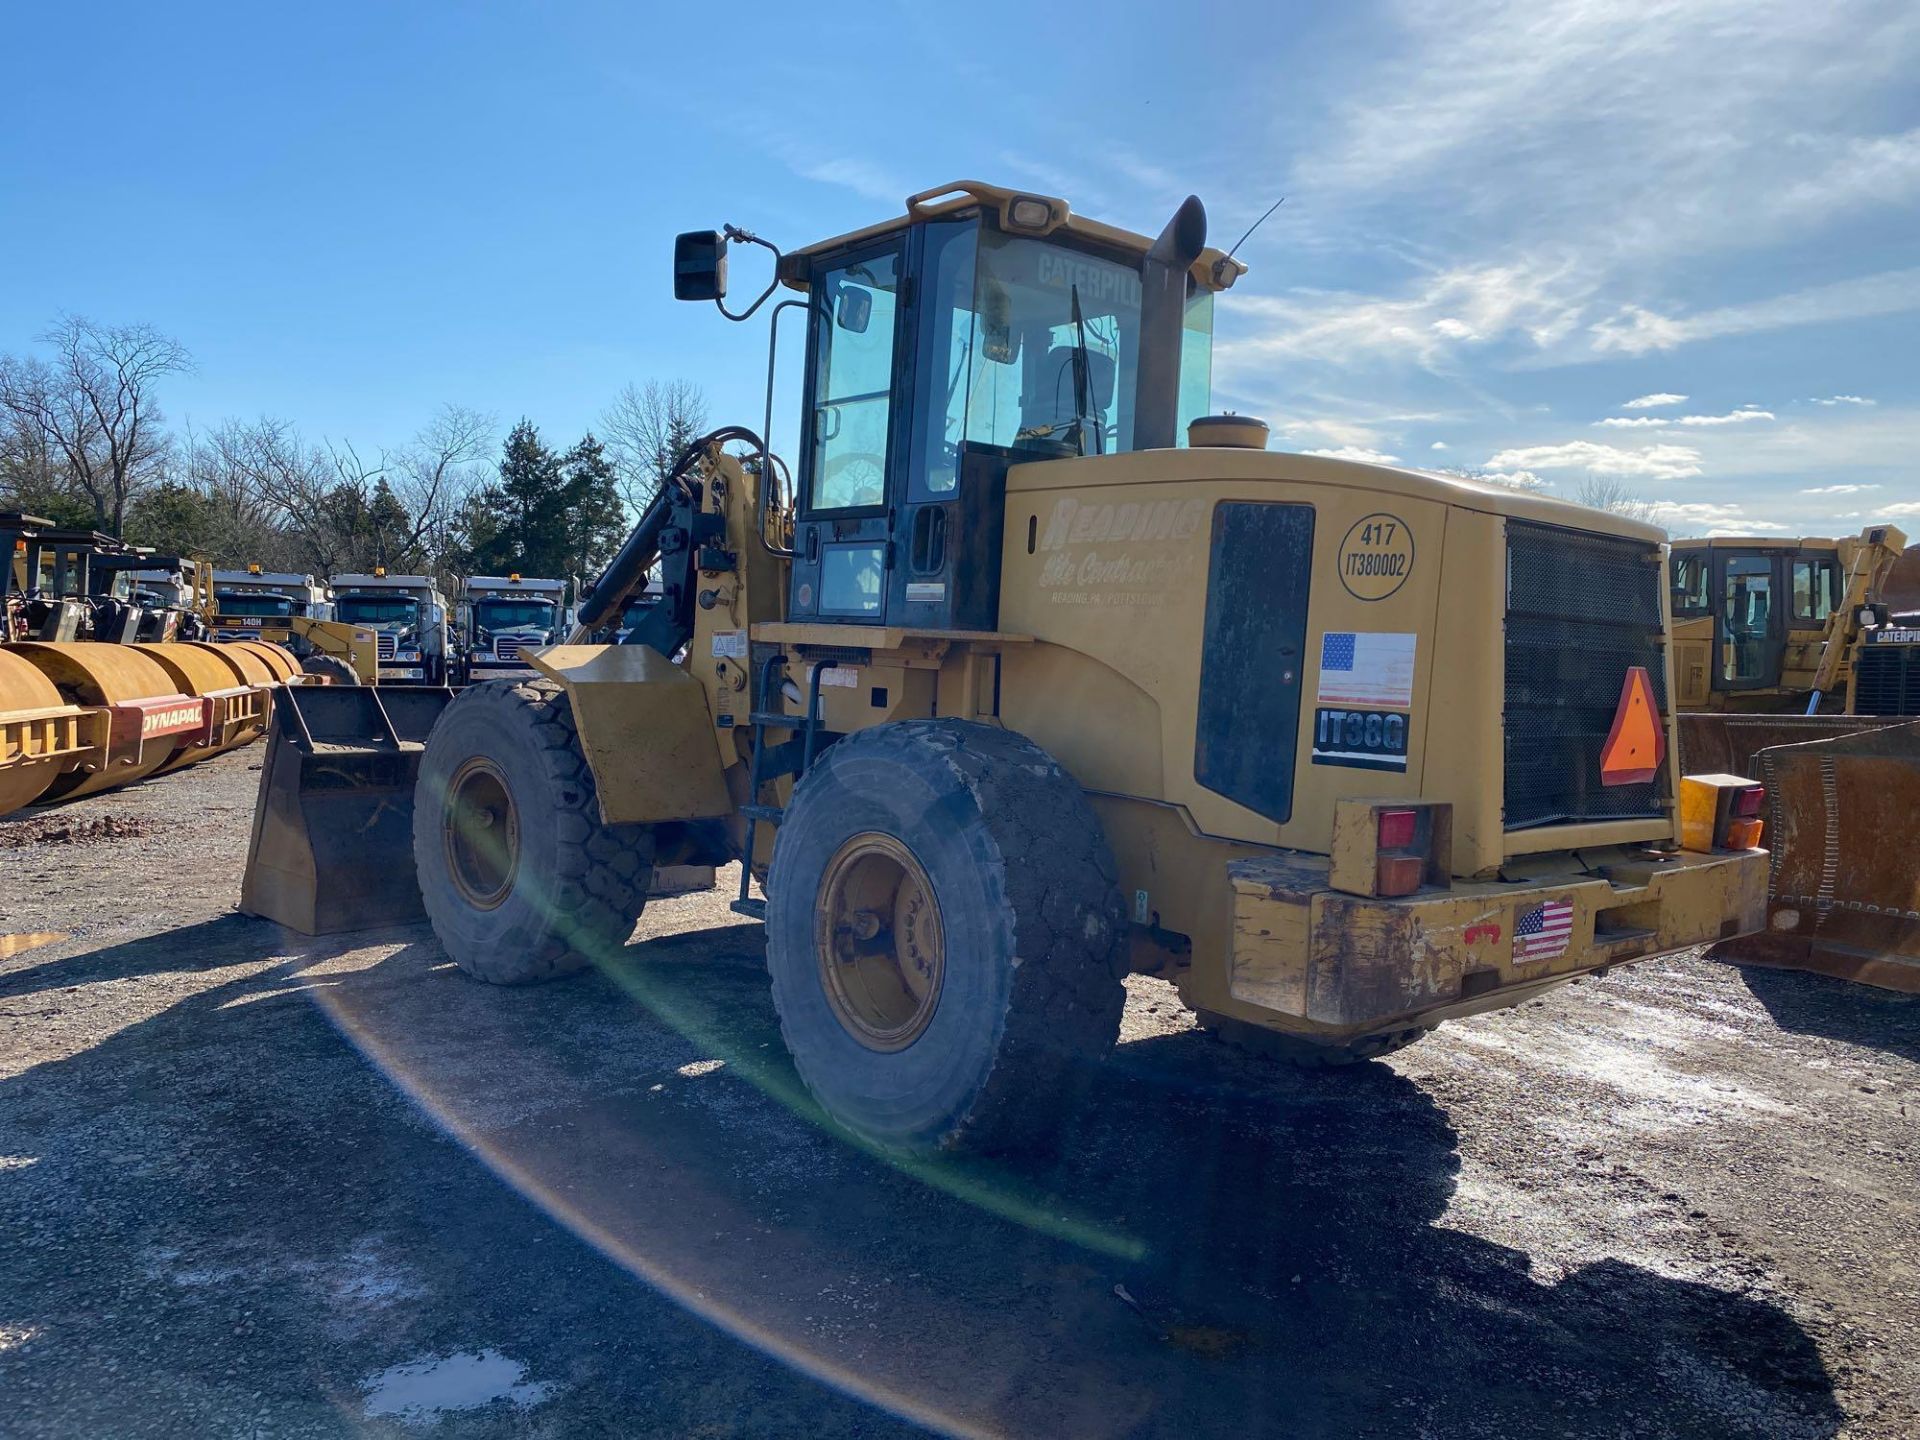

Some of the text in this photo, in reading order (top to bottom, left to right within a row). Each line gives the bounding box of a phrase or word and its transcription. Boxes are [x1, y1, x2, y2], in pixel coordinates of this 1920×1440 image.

[1040, 499, 1206, 550] READING
[1361, 523, 1396, 546] 417
[1345, 553, 1406, 577] IT380002
[242, 617, 262, 626] 140H
[144, 706, 202, 732] DYNAPAC
